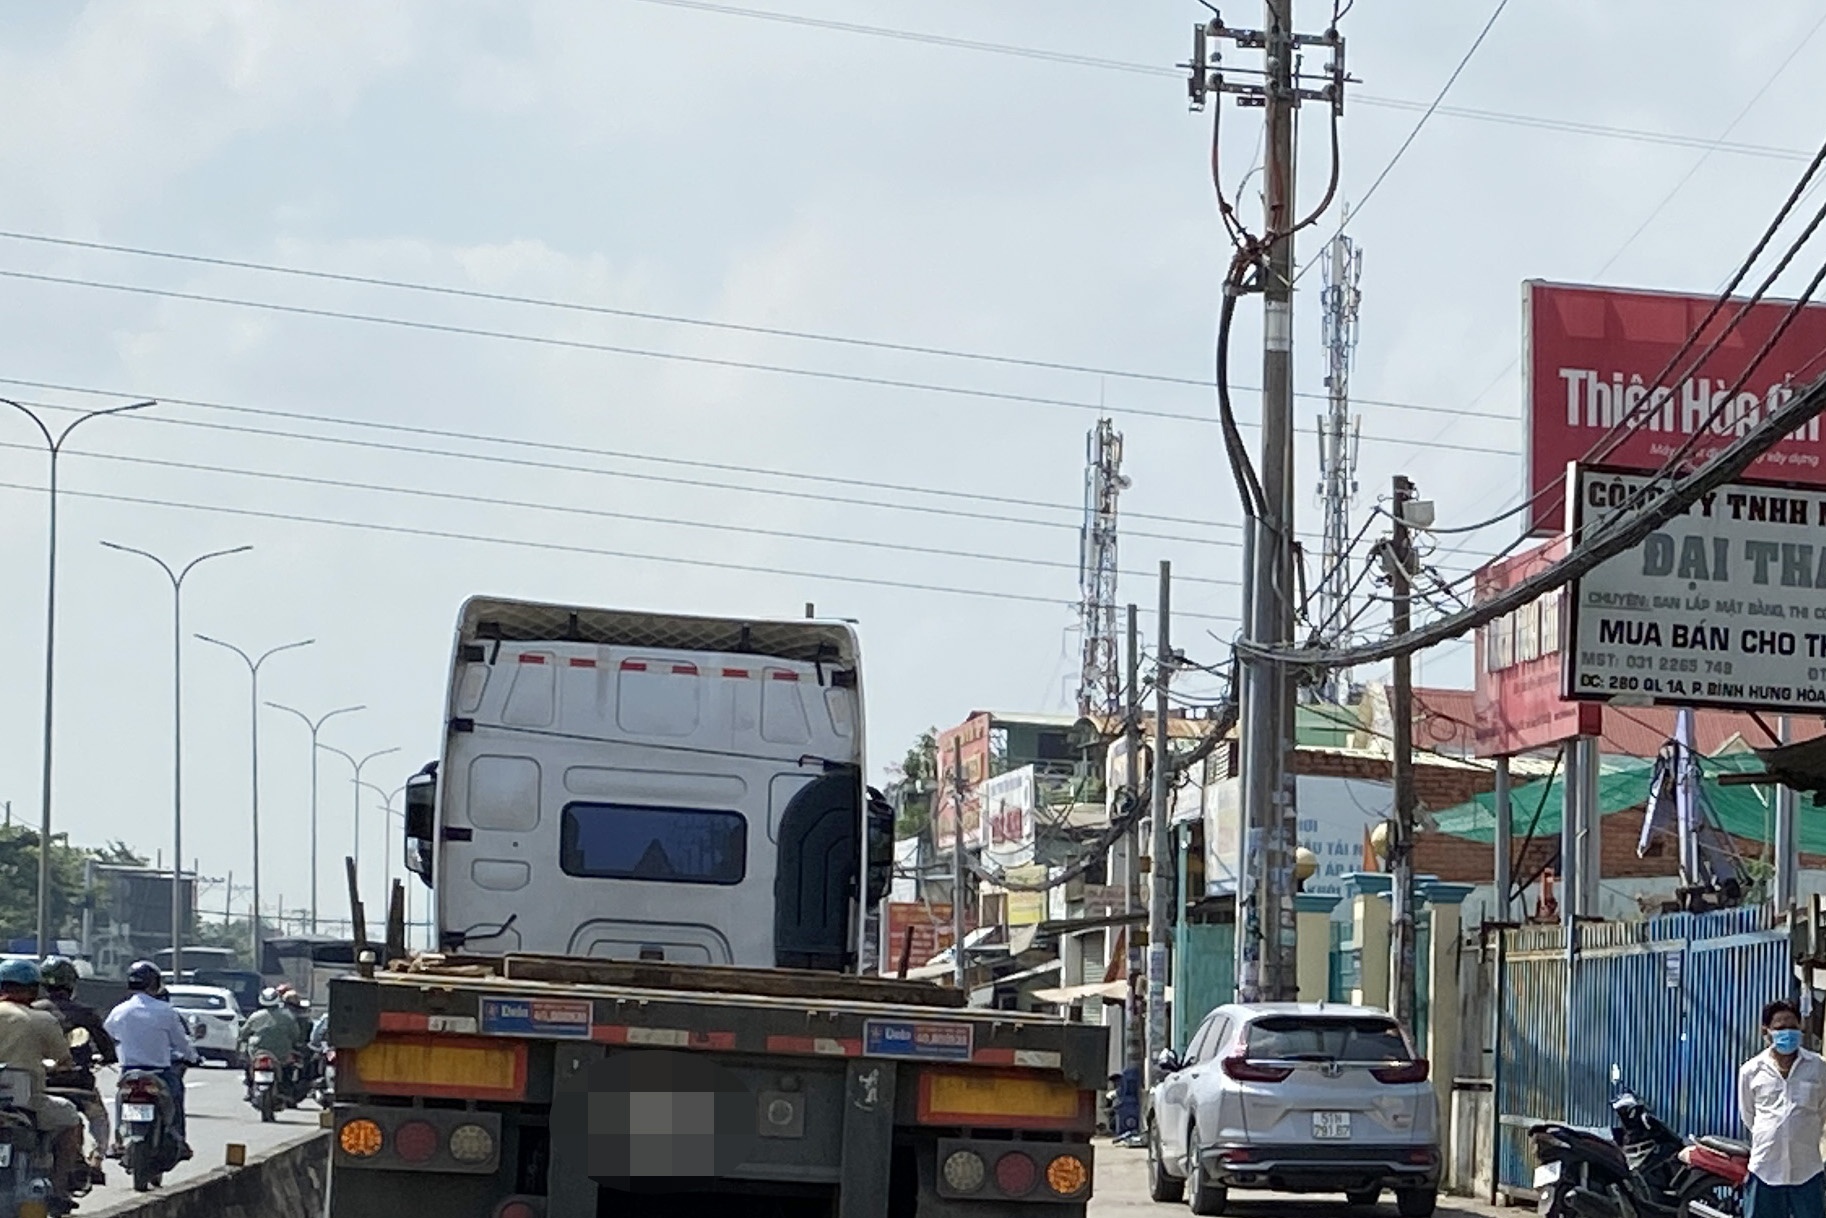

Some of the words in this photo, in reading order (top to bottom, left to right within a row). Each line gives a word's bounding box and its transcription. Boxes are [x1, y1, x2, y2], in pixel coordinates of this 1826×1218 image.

[1727, 493, 1808, 525] TNHH
[1599, 618, 1663, 648] MUA
[1672, 618, 1730, 651] BÁN
[1740, 629, 1796, 656] CHO
